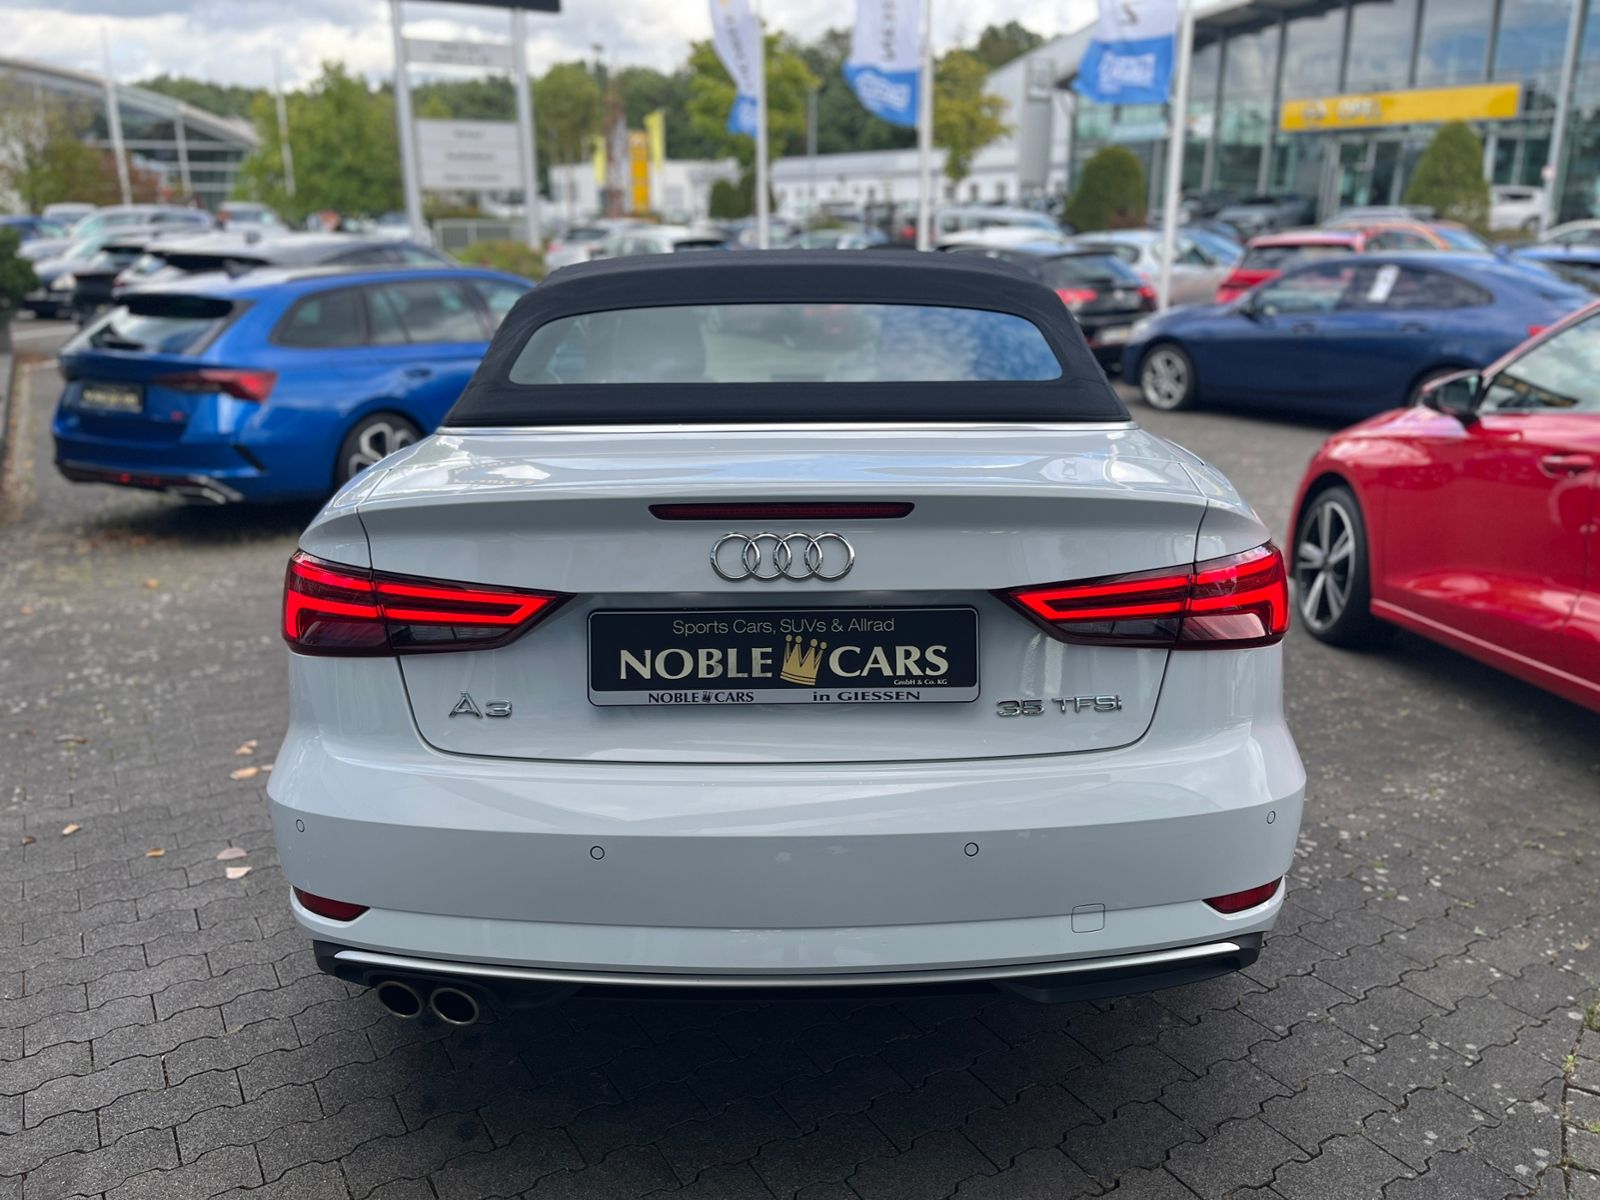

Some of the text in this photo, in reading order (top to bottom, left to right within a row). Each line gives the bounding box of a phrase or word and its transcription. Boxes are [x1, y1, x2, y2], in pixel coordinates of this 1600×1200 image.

[672, 617, 896, 637] Sports Cars, SUVs & Allrad
[619, 644, 950, 680] NOBLE CARS
[893, 678, 948, 686] GmbH & Co. KG
[448, 689, 514, 719] A3
[648, 690, 755, 704] NOBLE CARS
[813, 690, 921, 702] in GIESSEN
[996, 699, 1045, 717] 35
